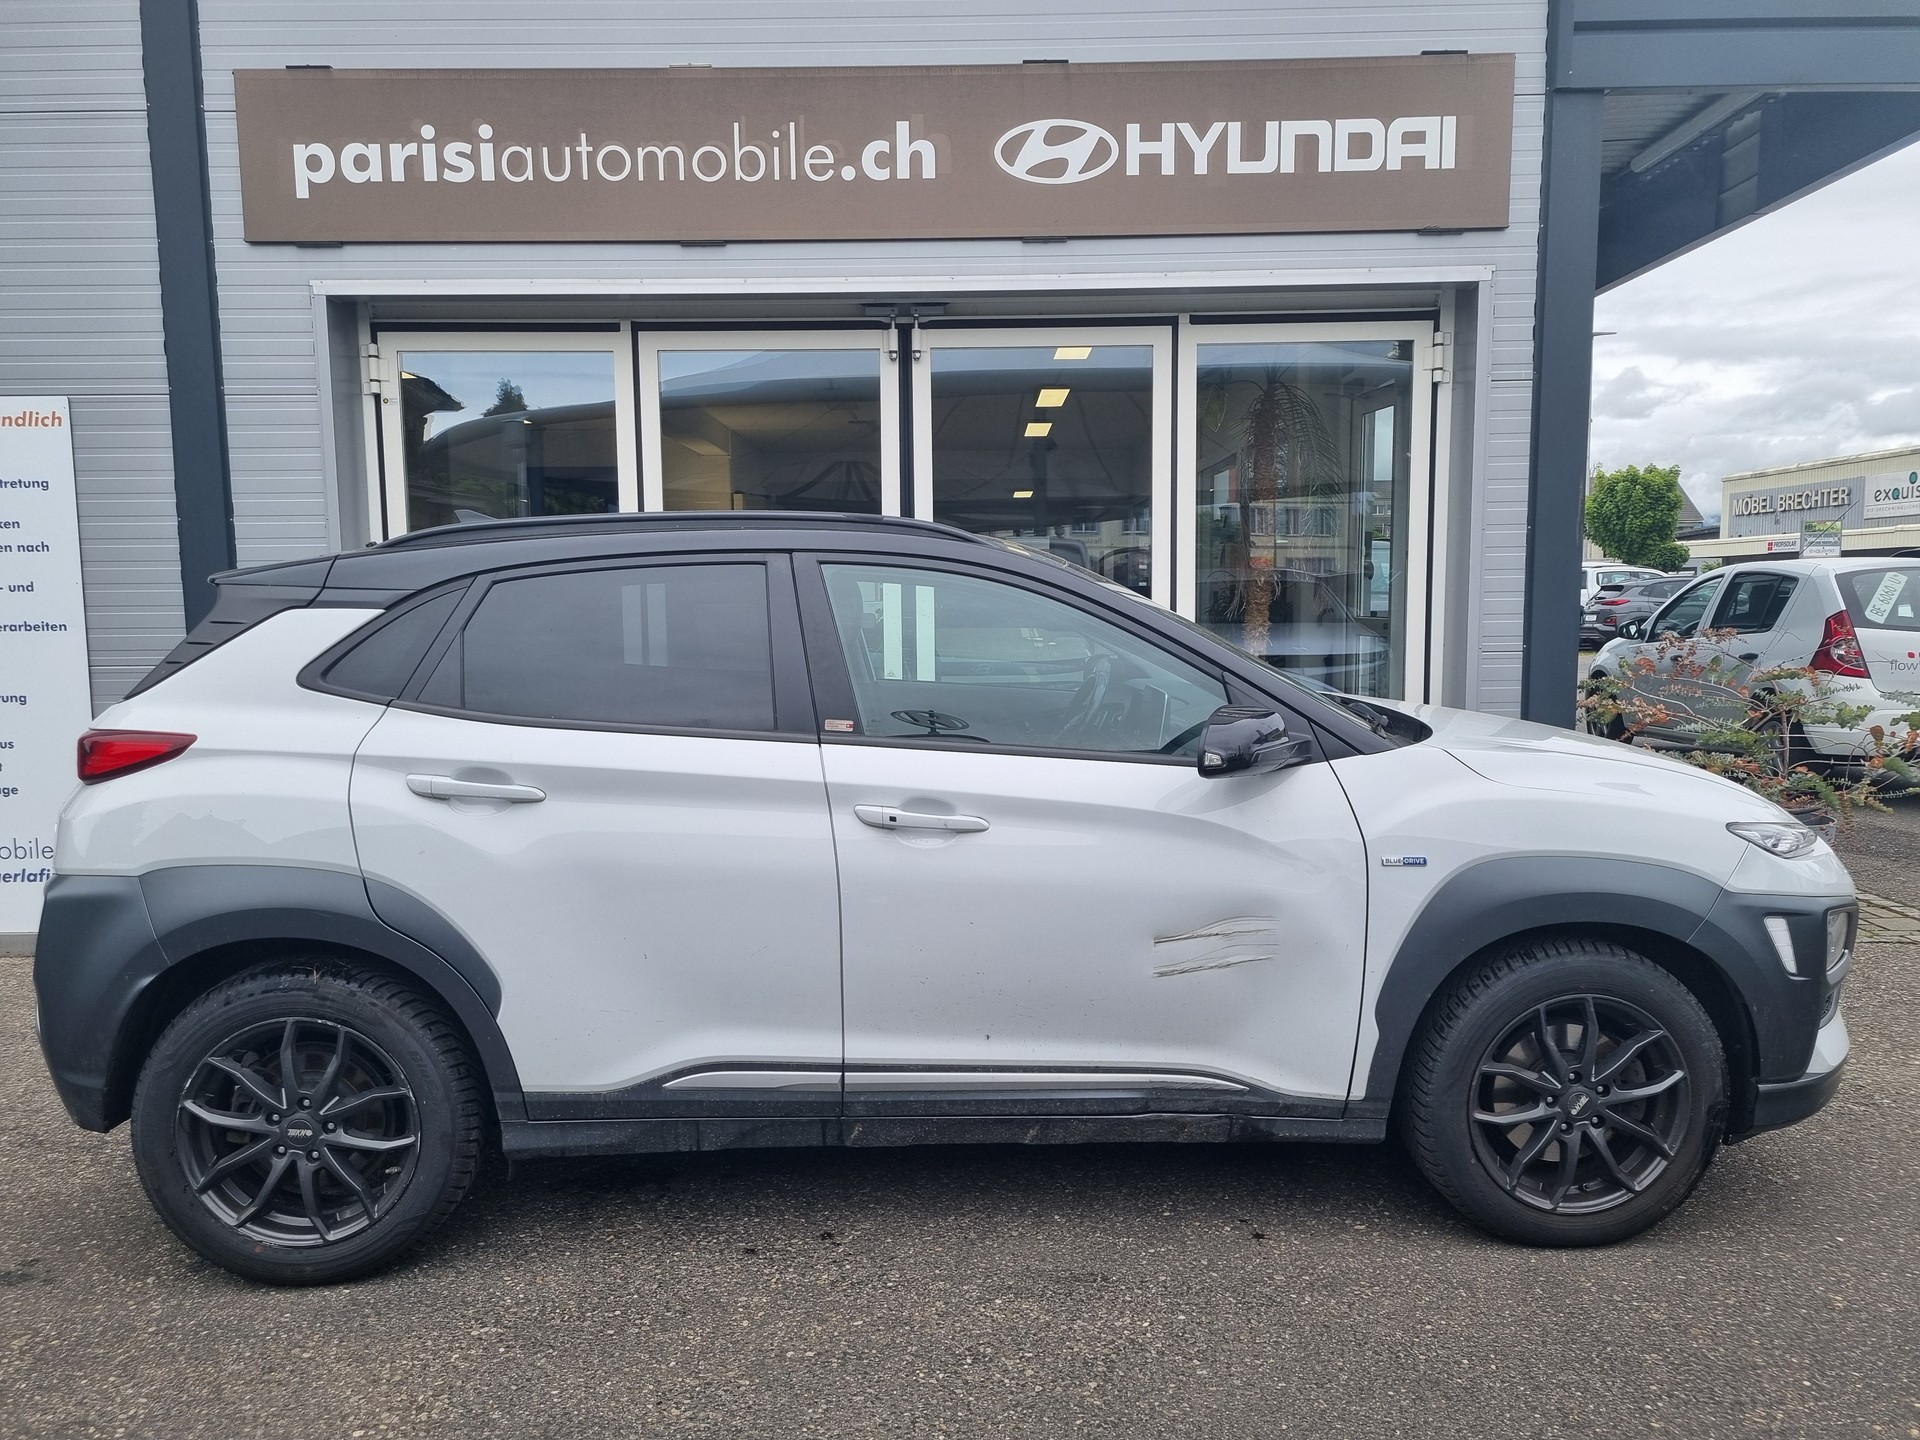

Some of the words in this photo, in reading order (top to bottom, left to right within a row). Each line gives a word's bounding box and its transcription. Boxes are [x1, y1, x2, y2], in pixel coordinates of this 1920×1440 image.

[1126, 115, 1457, 176] HYUNDAI
[293, 121, 937, 199] parisiautomobile.ch
[1, 411, 63, 427] ndlich
[1733, 494, 1776, 517] MÖBEL
[1777, 486, 1851, 512] BRECHTER
[17, 541, 50, 553] nach
[8, 581, 35, 592] und
[0, 695, 27, 706] ung
[0, 787, 19, 798] ge
